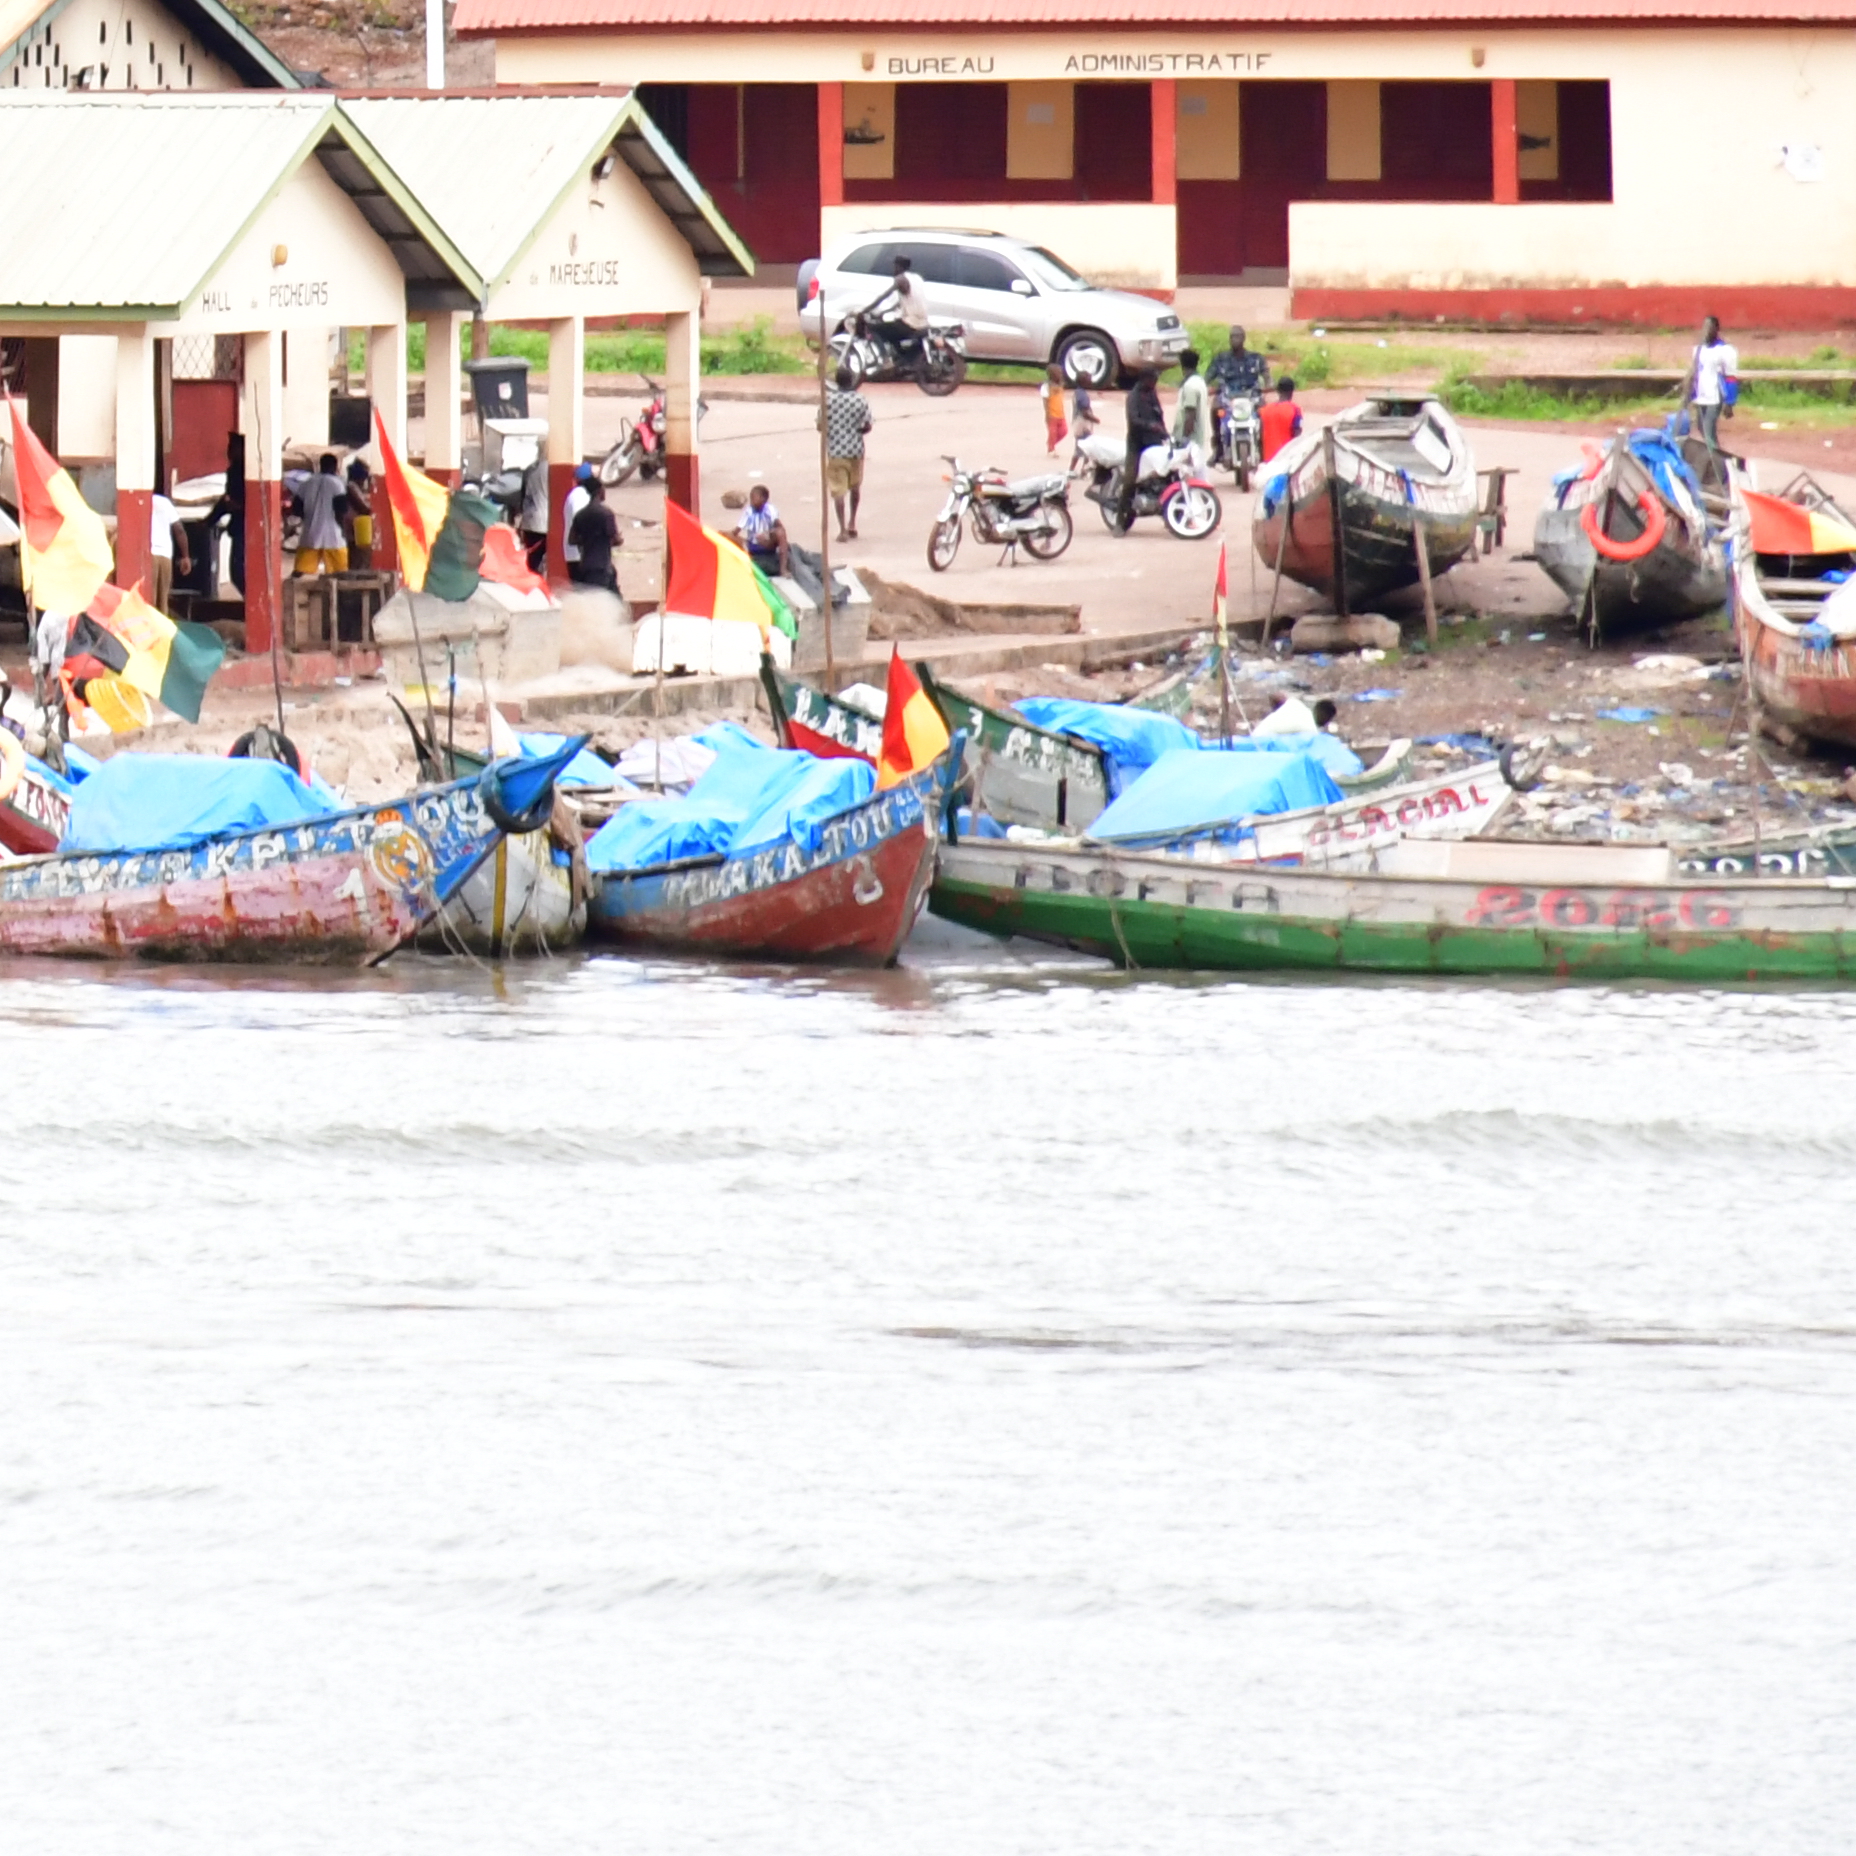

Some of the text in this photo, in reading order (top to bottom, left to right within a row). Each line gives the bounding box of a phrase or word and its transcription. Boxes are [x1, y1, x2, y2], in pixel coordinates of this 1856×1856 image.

[888, 52, 1272, 75] BUREAU ADMINISTRATIF
[549, 260, 619, 285] MAREYEUSE
[202, 291, 231, 314] HALL
